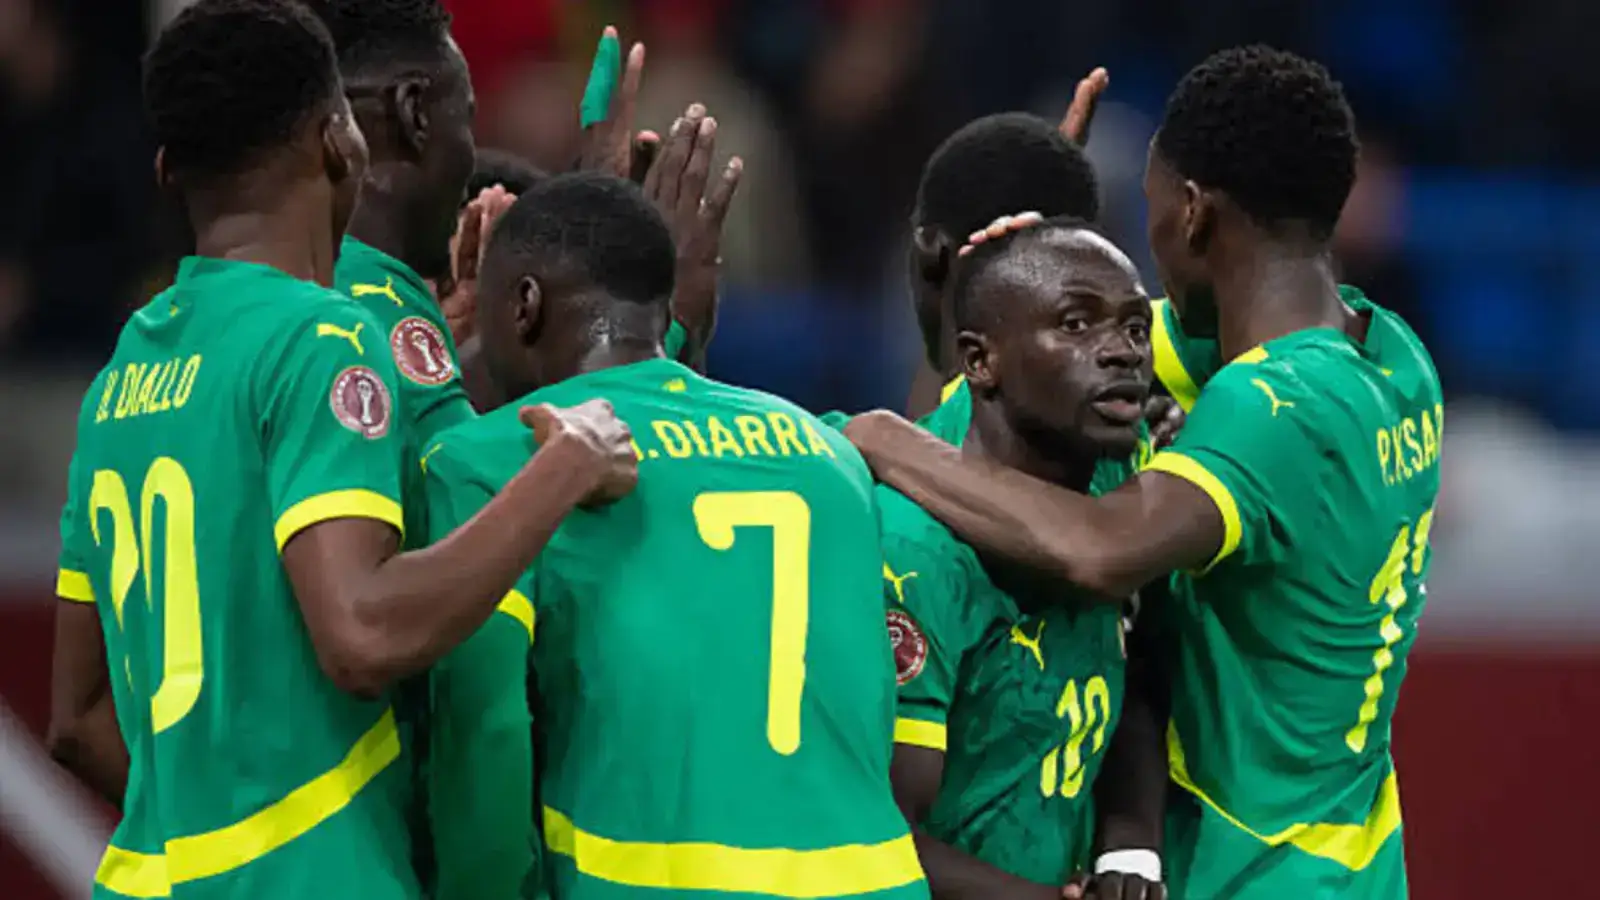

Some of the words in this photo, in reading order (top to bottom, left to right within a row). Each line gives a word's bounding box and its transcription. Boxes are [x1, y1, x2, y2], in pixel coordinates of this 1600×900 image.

[630, 412, 836, 461] .DIARRA
[692, 491, 811, 756] 7
[1345, 511, 1432, 752] 1
[1040, 676, 1110, 798] 10
